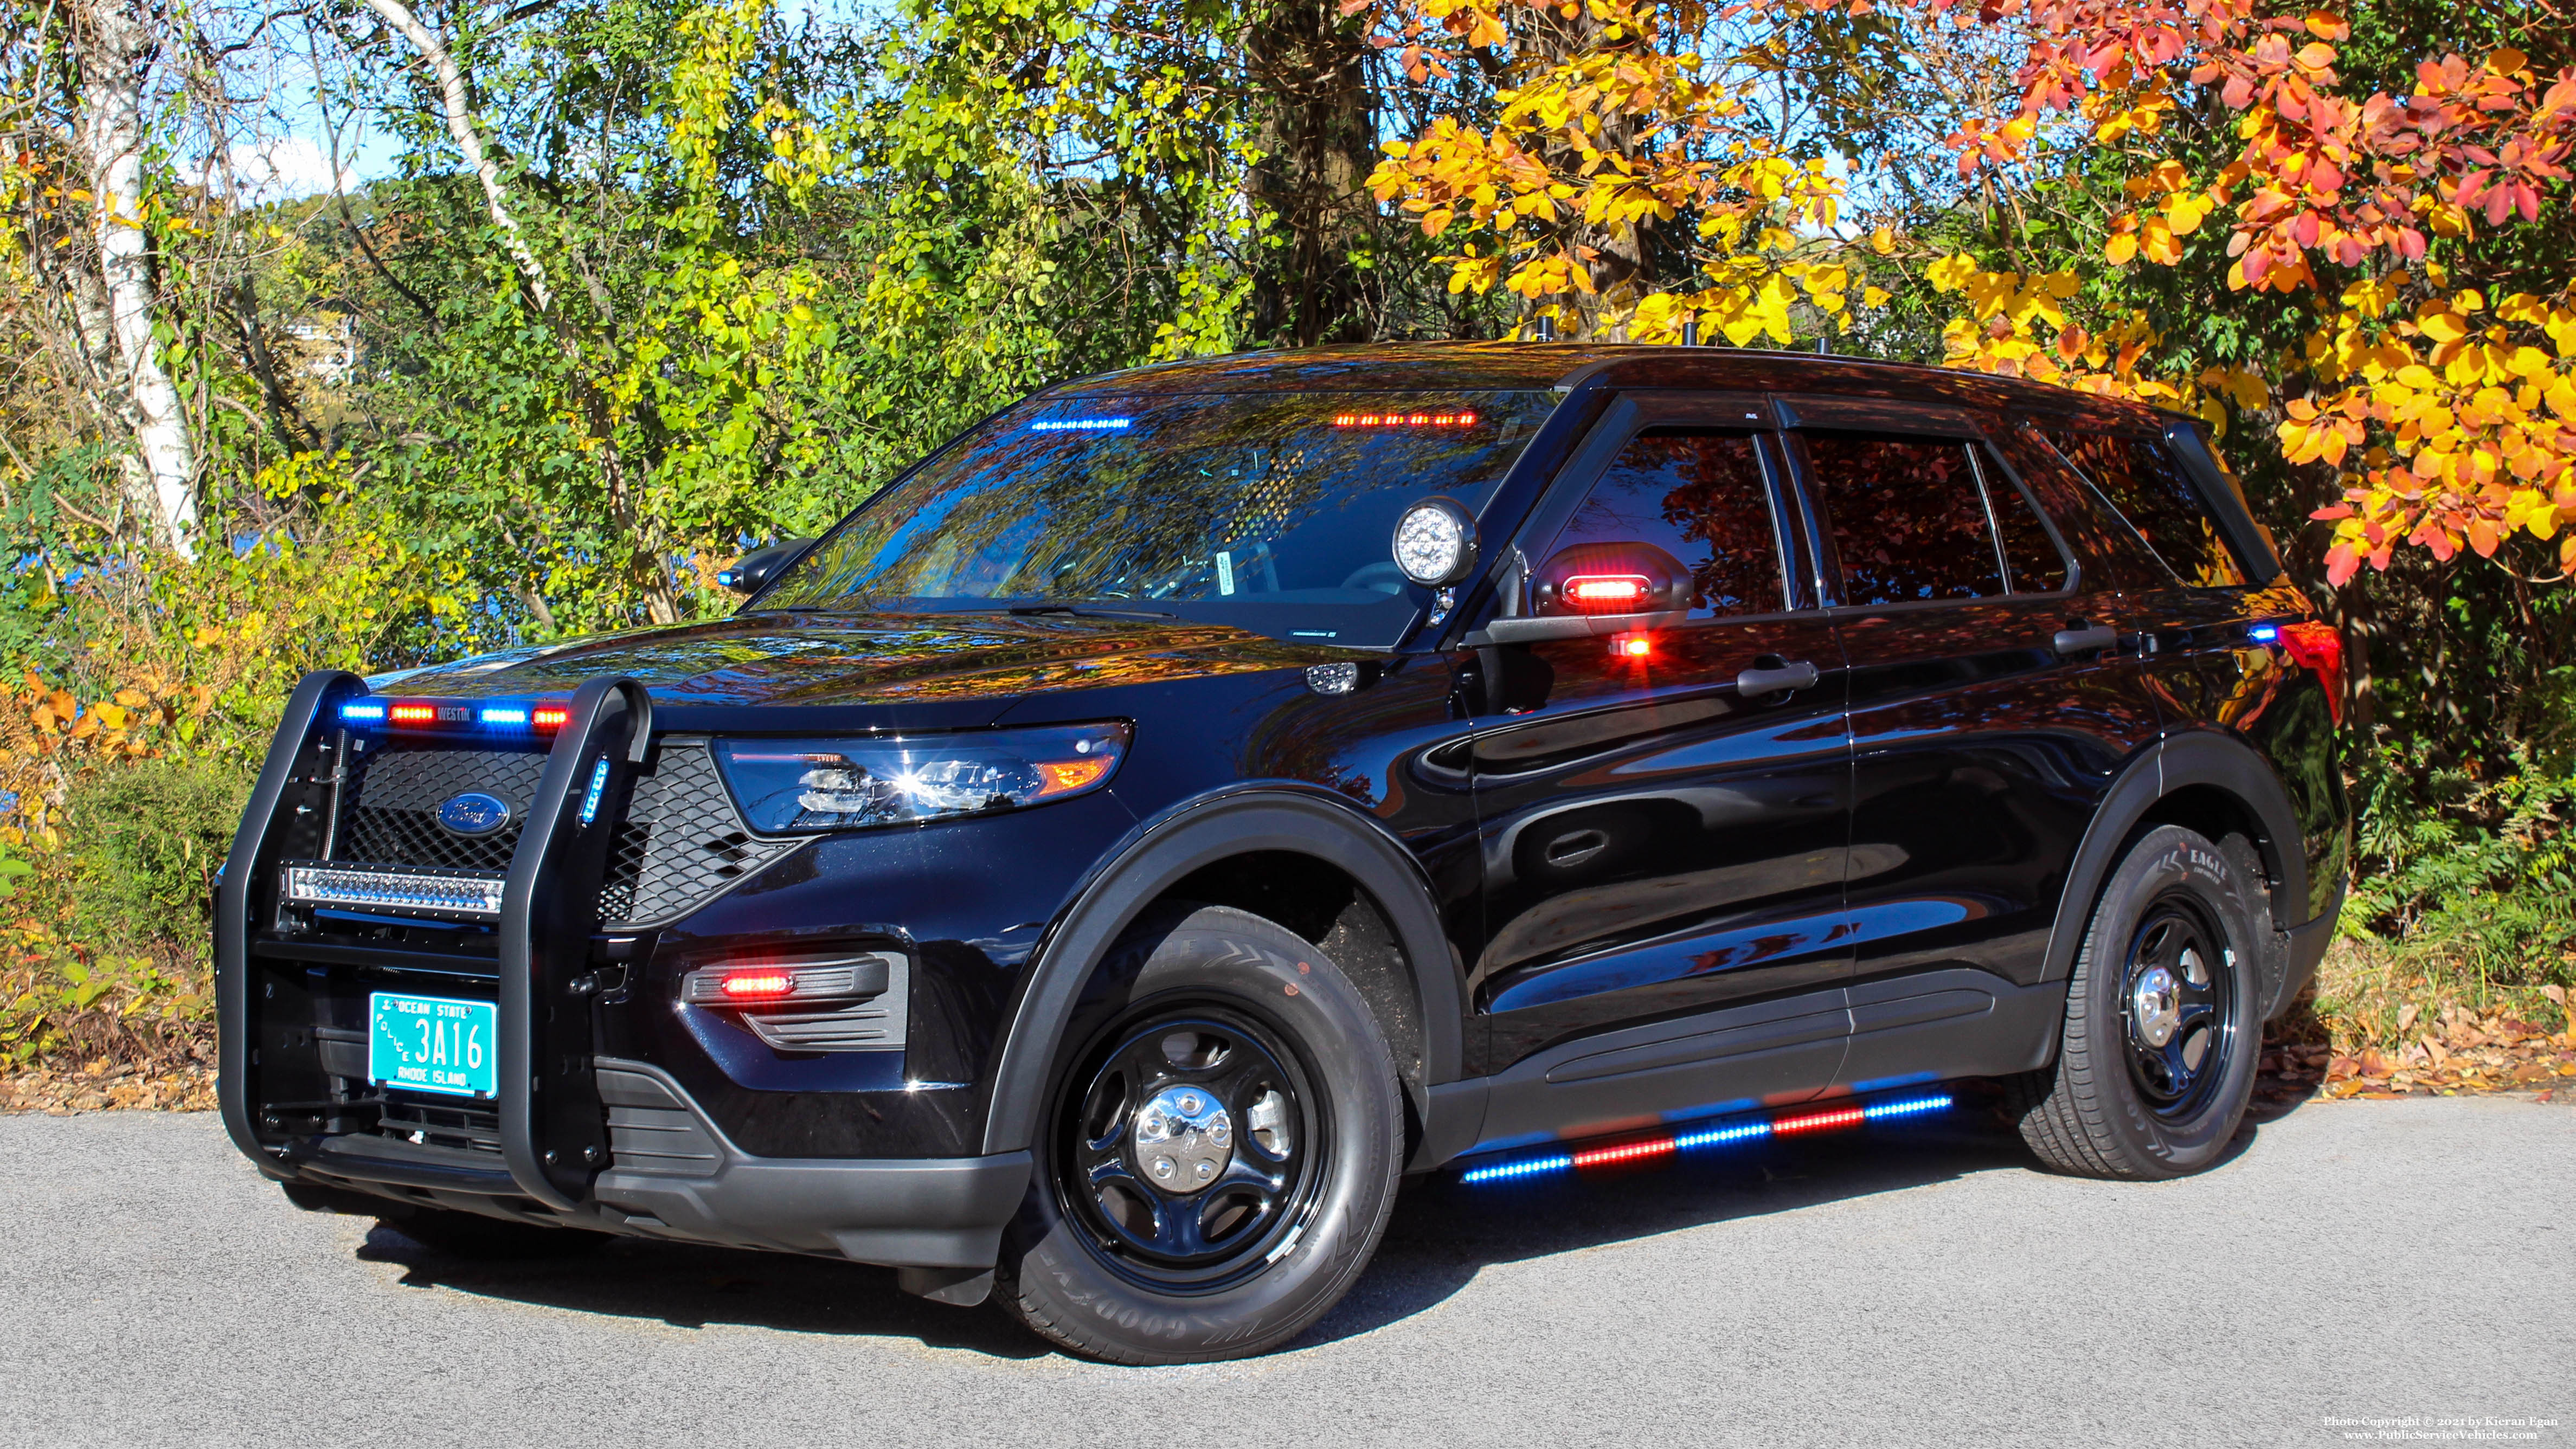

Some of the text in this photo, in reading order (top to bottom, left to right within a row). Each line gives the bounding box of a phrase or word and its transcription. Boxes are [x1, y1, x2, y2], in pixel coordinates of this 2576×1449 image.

[448, 802, 489, 824] Ford
[2190, 849, 2228, 880] EAGLE
[398, 1000, 468, 1020] OCEAN STATE
[376, 1013, 410, 1062] POLICE
[415, 1018, 482, 1070] 3A16
[397, 1066, 466, 1087] RHODE ISLAND
